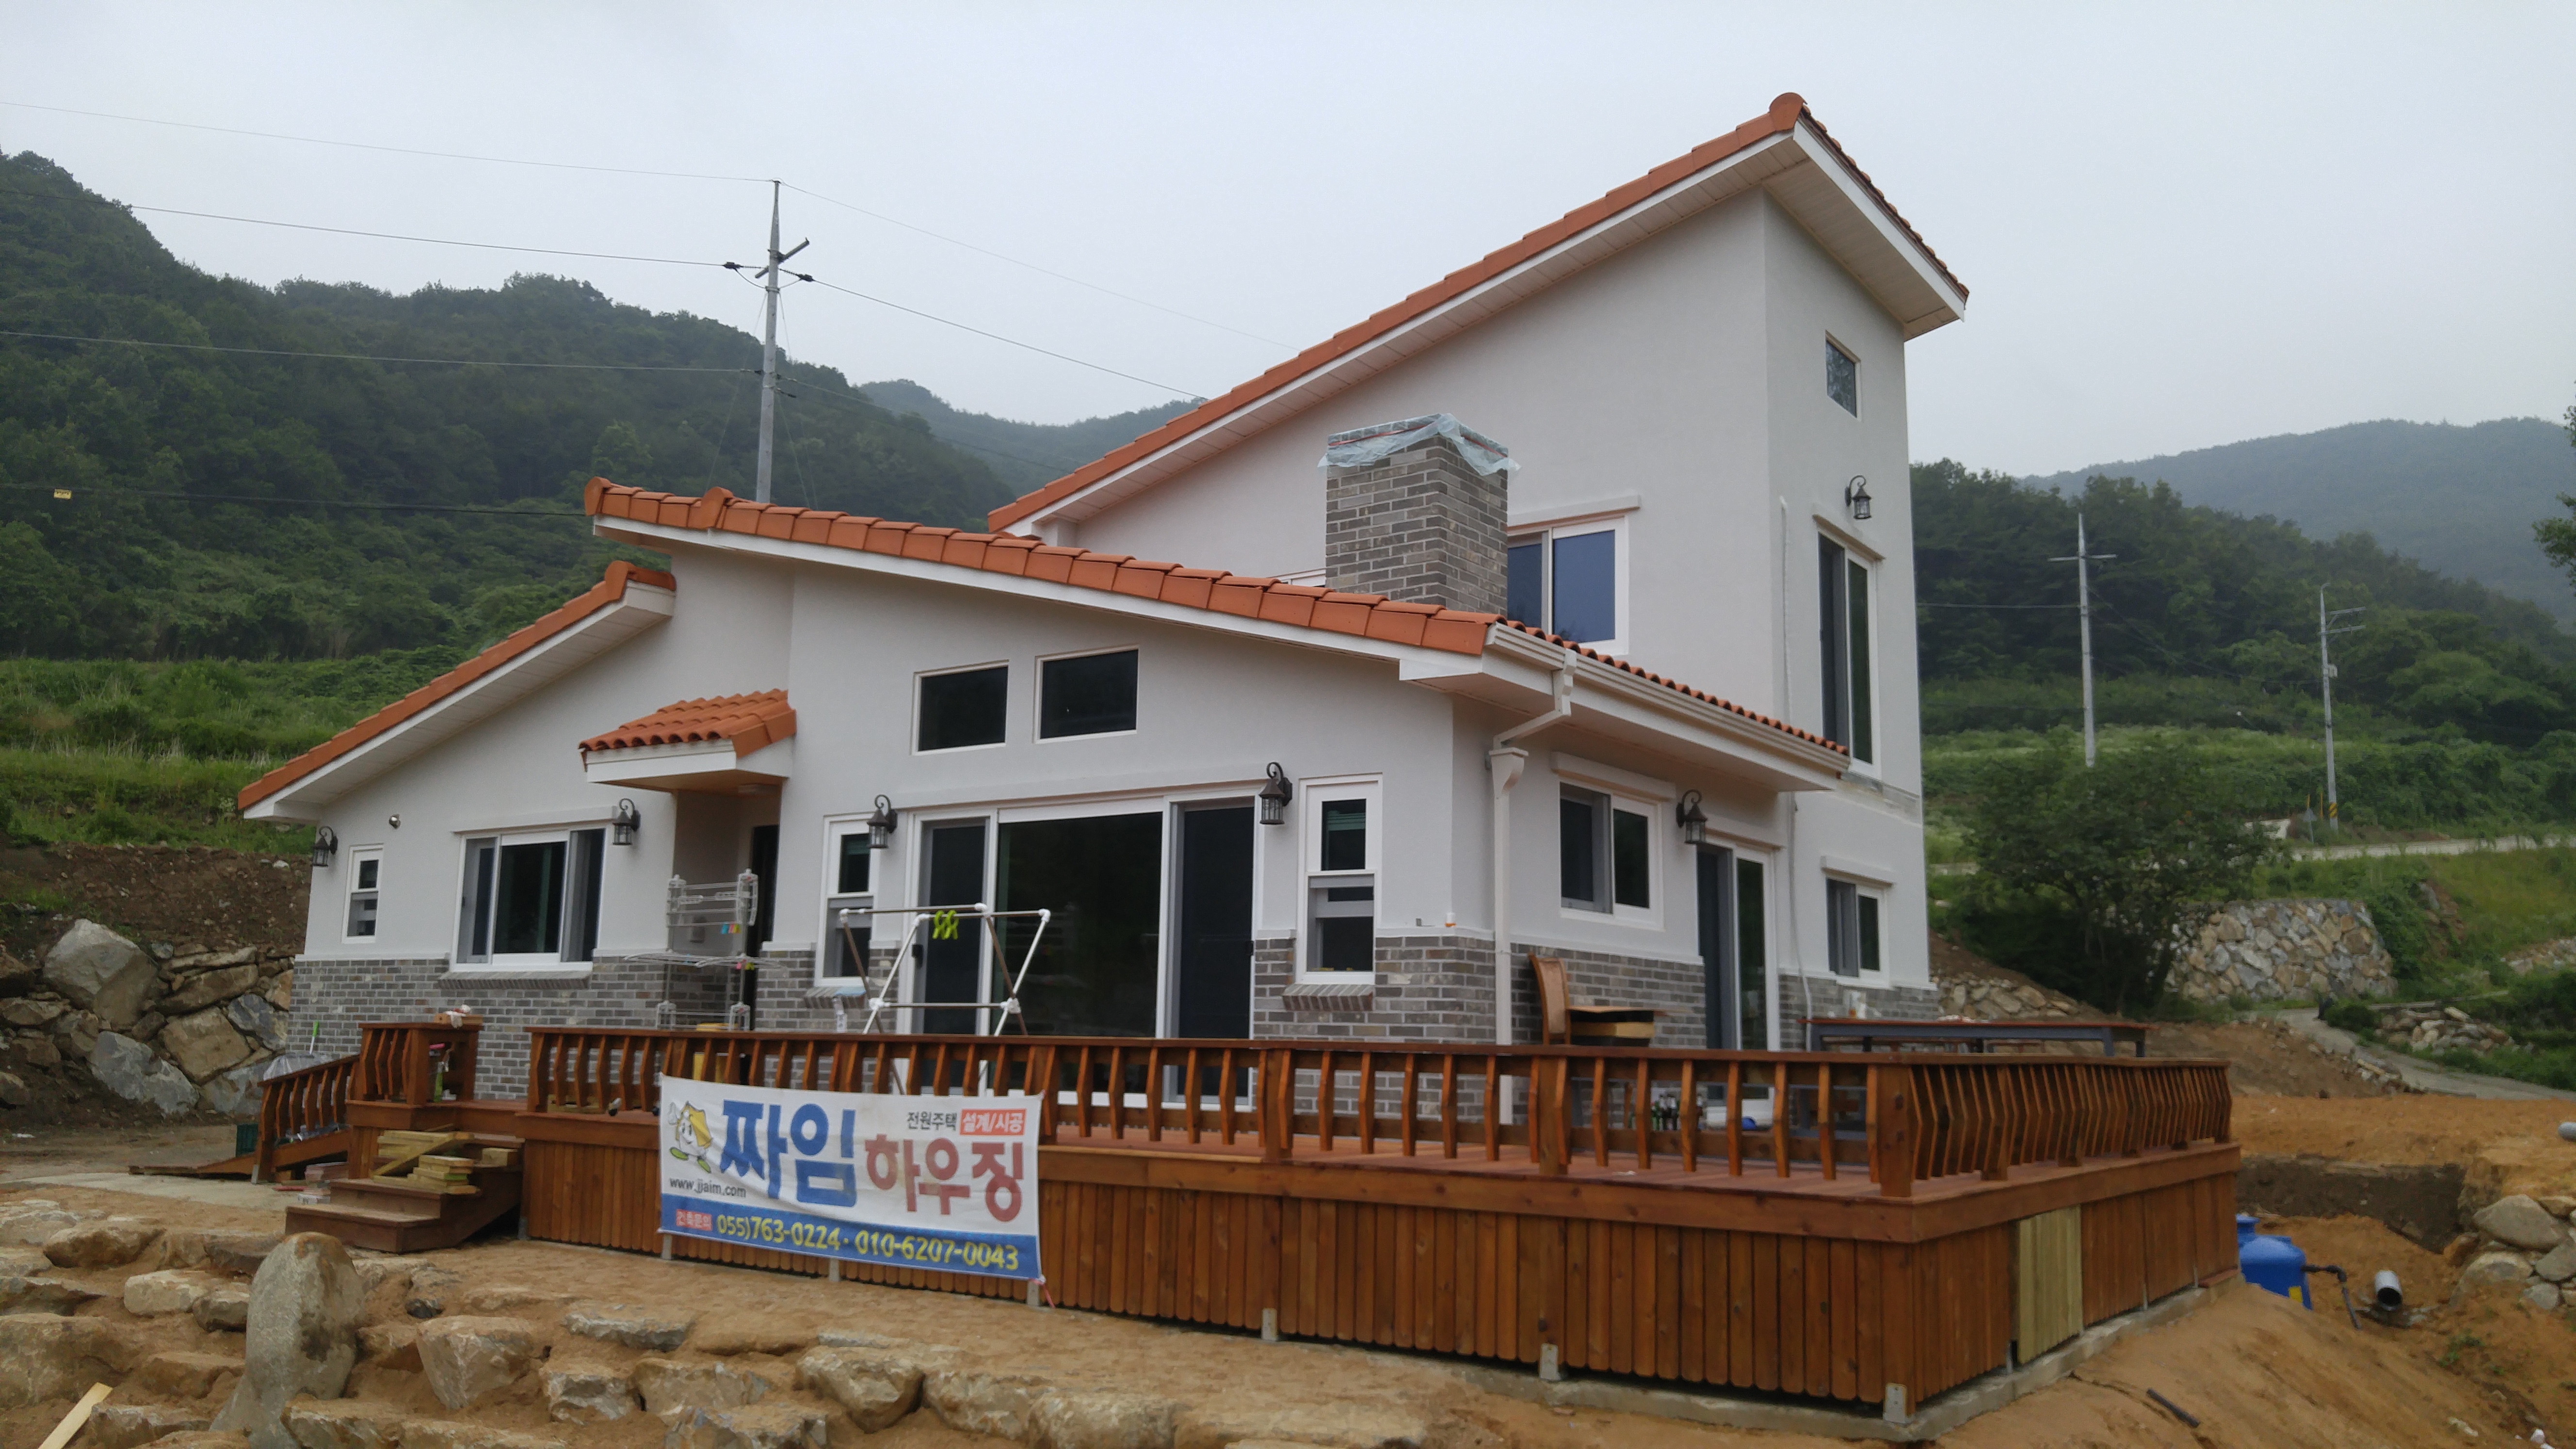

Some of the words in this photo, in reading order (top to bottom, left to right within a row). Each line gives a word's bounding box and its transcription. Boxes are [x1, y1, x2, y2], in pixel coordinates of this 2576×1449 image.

[907, 1111, 957, 1130] 전원주택
[963, 1112, 1024, 1133] 설계/시공
[720, 1099, 857, 1208] 짜임
[865, 1134, 1024, 1222] 하우징
[669, 1177, 746, 1198] www.jjaim.com
[717, 1214, 841, 1251] 055)763-0224
[854, 1230, 1018, 1271] 010-6207-0043
